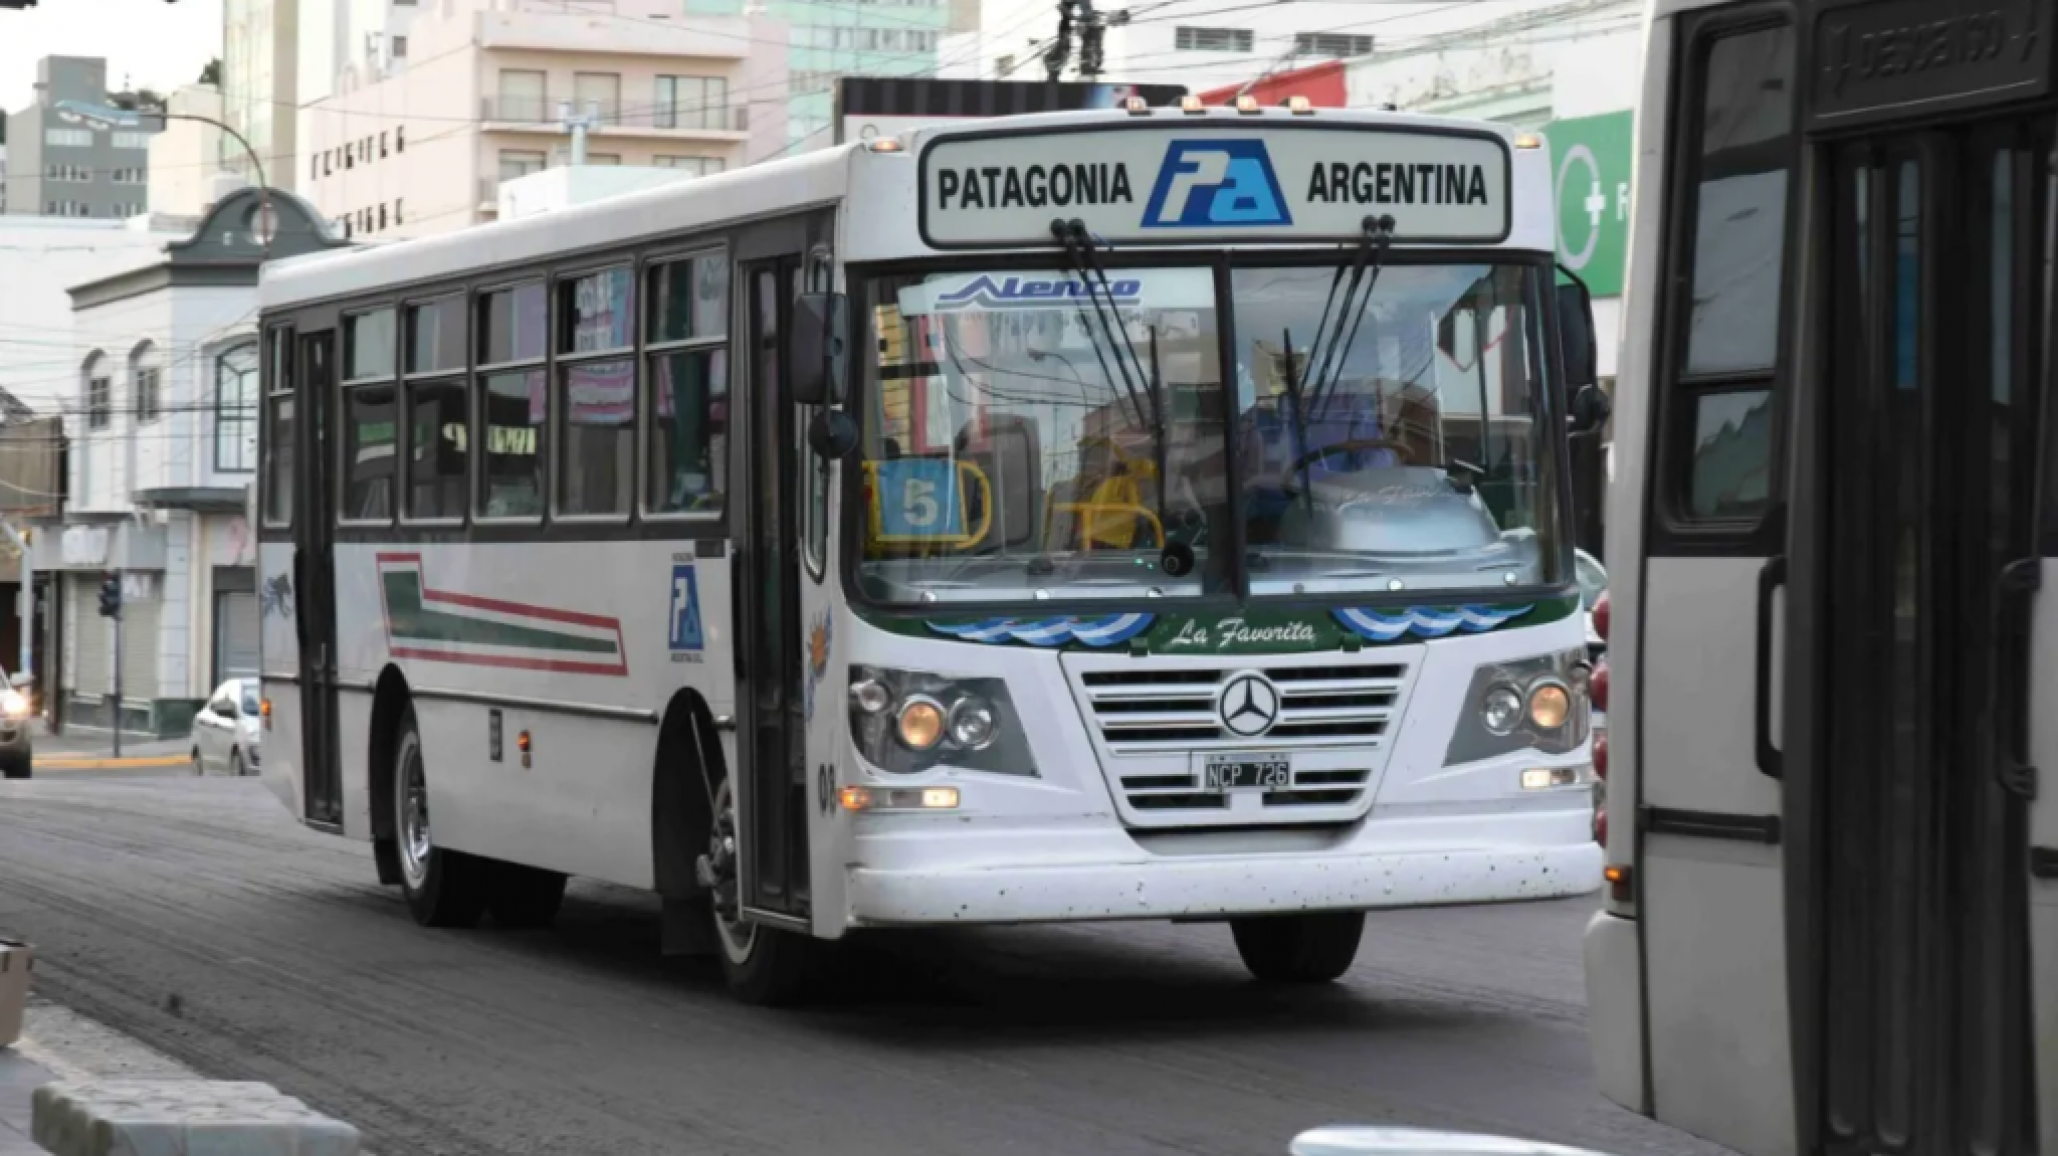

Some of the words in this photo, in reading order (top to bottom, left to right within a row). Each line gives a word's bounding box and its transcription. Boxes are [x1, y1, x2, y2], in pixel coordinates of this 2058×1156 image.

[938, 162, 1133, 209] PATAGONIA
[1306, 162, 1488, 205] ARGENTINA
[904, 478, 938, 527] 5
[1163, 618, 1208, 650] La
[1214, 616, 1317, 650] Favorita
[1208, 764, 1243, 787] NCP
[1254, 763, 1288, 786] 726
